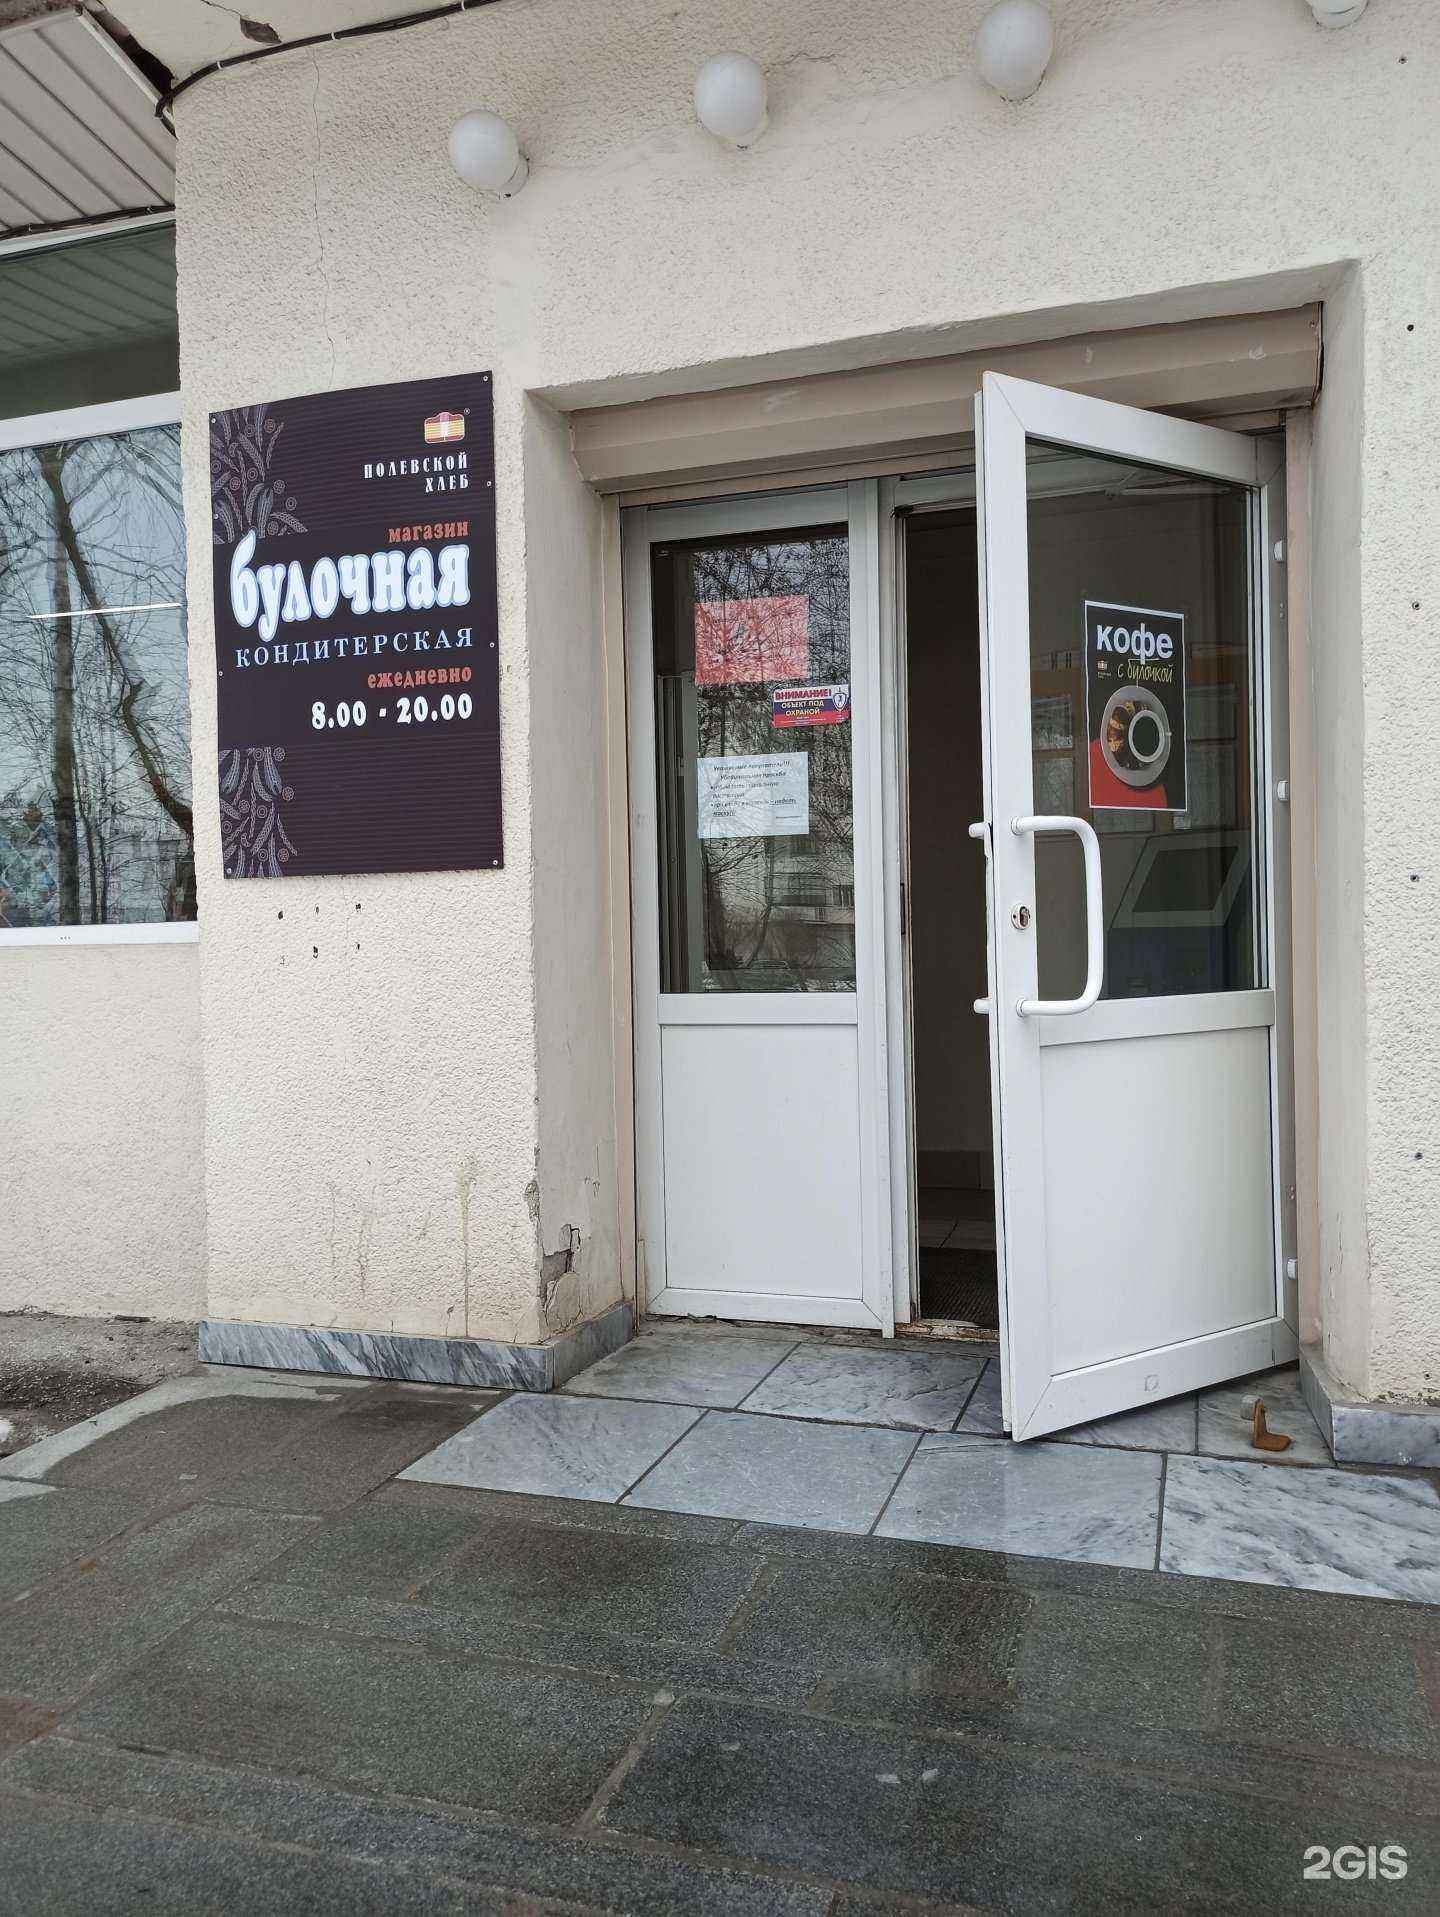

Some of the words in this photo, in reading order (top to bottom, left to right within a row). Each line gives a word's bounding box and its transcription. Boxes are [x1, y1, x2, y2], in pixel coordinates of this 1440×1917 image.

[364, 451, 468, 479] ПОЛЕВСКОЙ
[425, 473, 469, 493] ХЛЕБ
[388, 520, 469, 544] магазин
[230, 529, 471, 642] булочная
[235, 627, 473, 669] КОНДИТЕРСКАЯ
[1096, 622, 1174, 665] кофе
[367, 665, 472, 689] ежедневно
[775, 688, 831, 701] ВНИМАНИЕ!
[781, 701, 807, 709] ОБЪЕКТ
[808, 700, 825, 708] ПОД
[311, 700, 367, 730] 8.00
[396, 693, 473, 725] 20.00
[785, 707, 820, 717] ОХРАНОЙ
